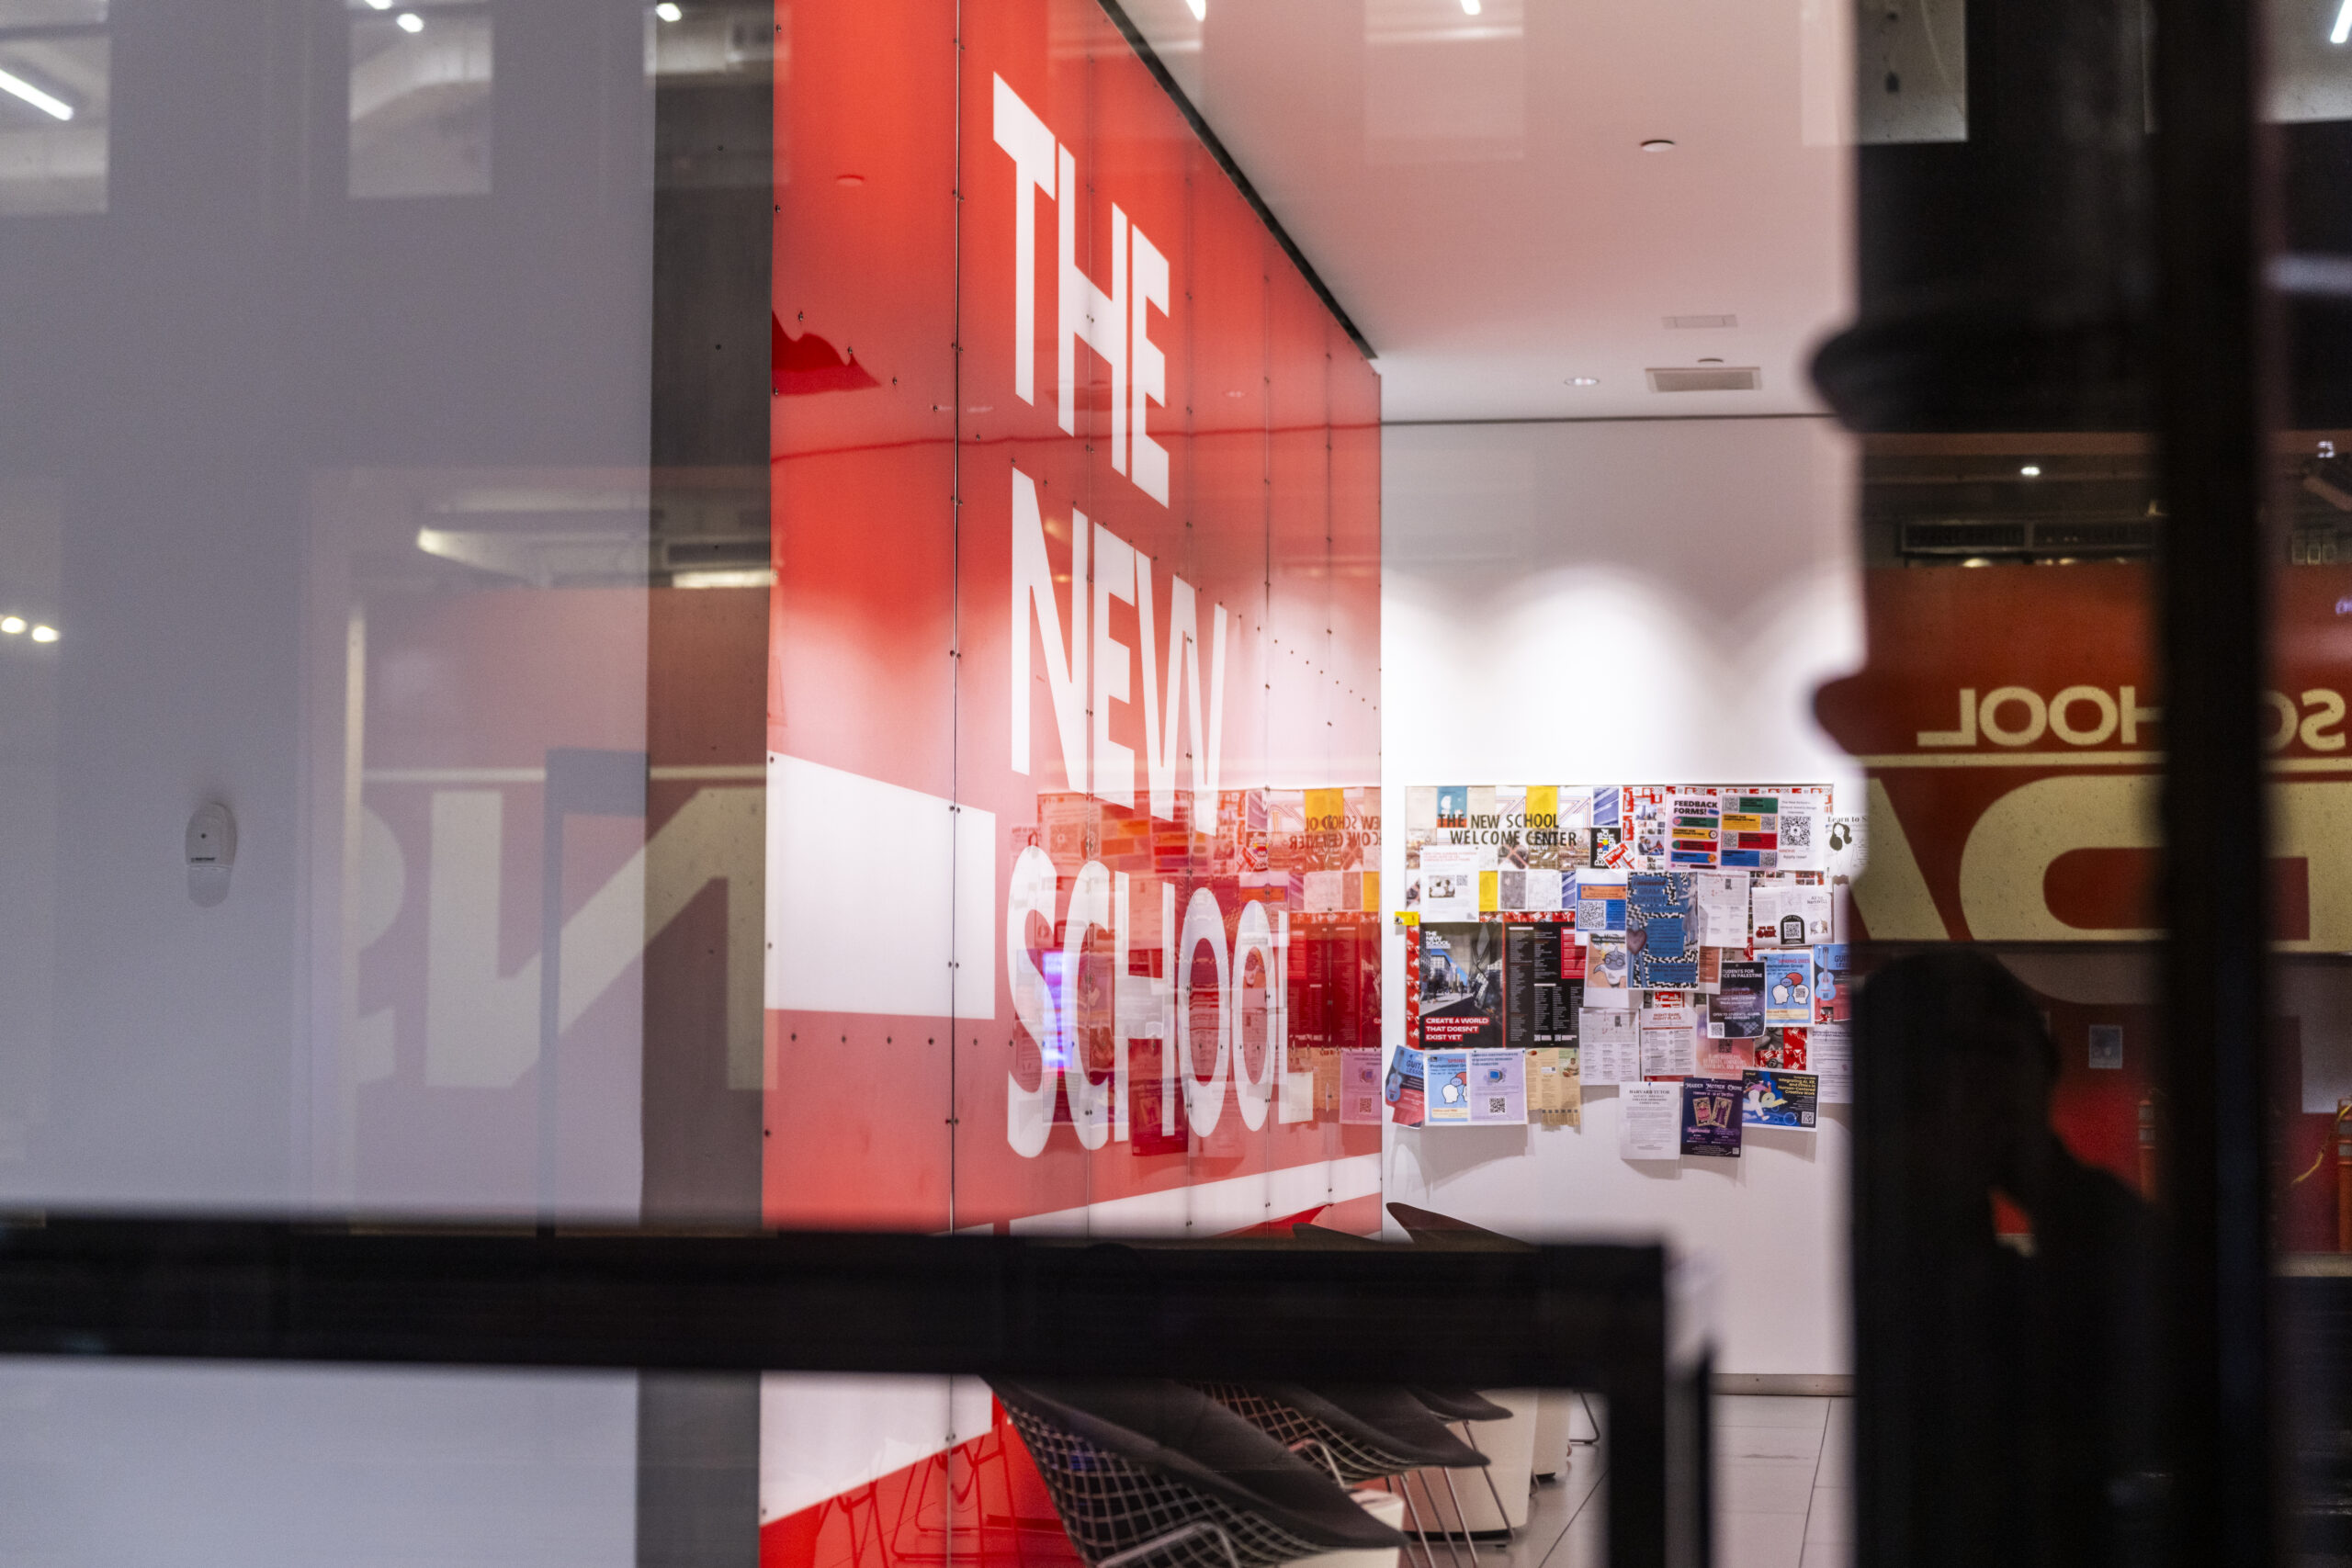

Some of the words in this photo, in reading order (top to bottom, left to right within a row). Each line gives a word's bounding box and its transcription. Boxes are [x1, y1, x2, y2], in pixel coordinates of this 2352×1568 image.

[993, 71, 1170, 509] THE
[1011, 467, 1227, 836] NEW
[1438, 814, 1464, 828] THE
[1471, 814, 1499, 829] NEW
[1506, 814, 1560, 829] SCHOOL
[1450, 829, 1521, 845] WELCOME
[1525, 830, 1577, 846] CENTER
[1673, 799, 1718, 808] FEEDBACK
[1007, 845, 1315, 1157] SCHOOL
